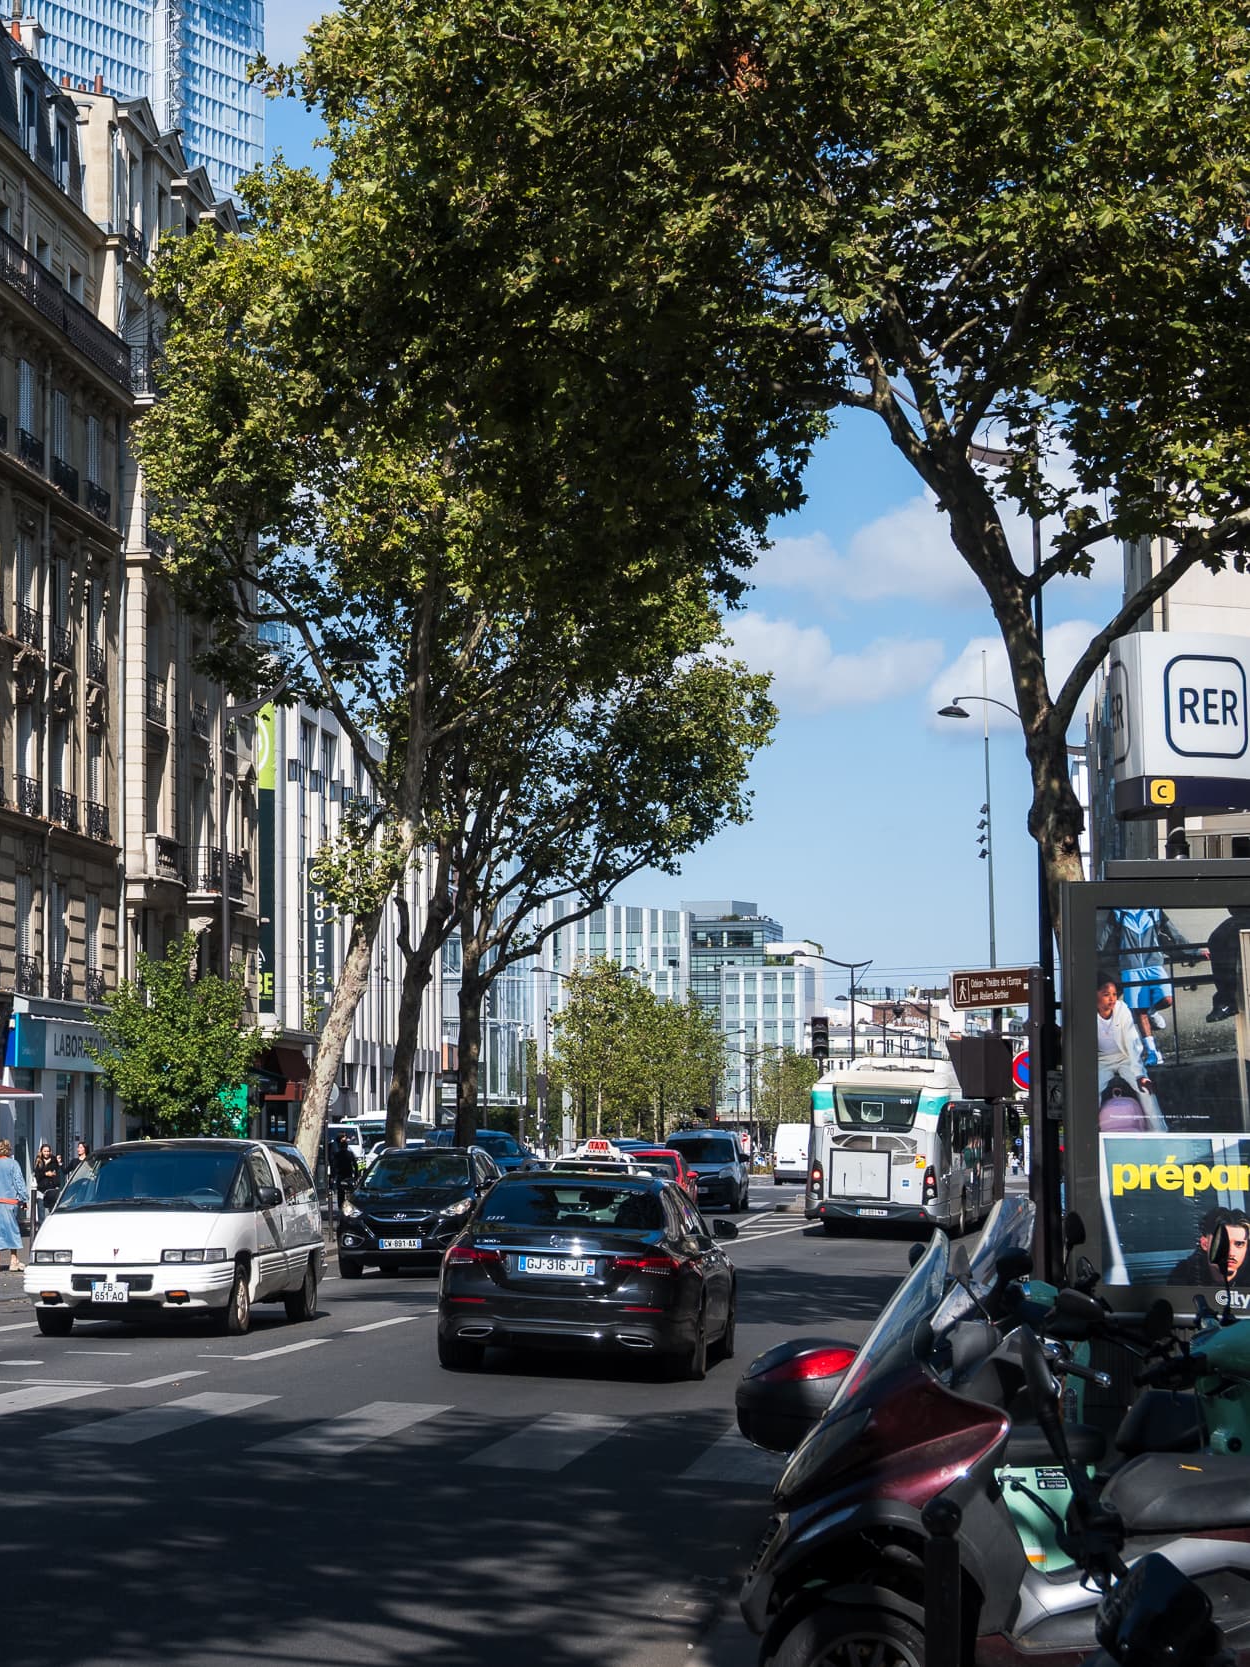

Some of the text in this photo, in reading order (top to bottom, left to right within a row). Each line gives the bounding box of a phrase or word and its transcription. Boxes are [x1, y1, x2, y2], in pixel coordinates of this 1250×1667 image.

[1179, 688, 1238, 726] RER
[1157, 785, 1168, 799] C
[314, 891, 325, 985] HOTELS
[986, 977, 1000, 987] Théâtre
[53, 1032, 108, 1060] LABORATOIR
[589, 1141, 608, 1150] TAXI
[1112, 1155, 1250, 1196] prépar
[527, 1258, 586, 1272] GJ-316-JT
